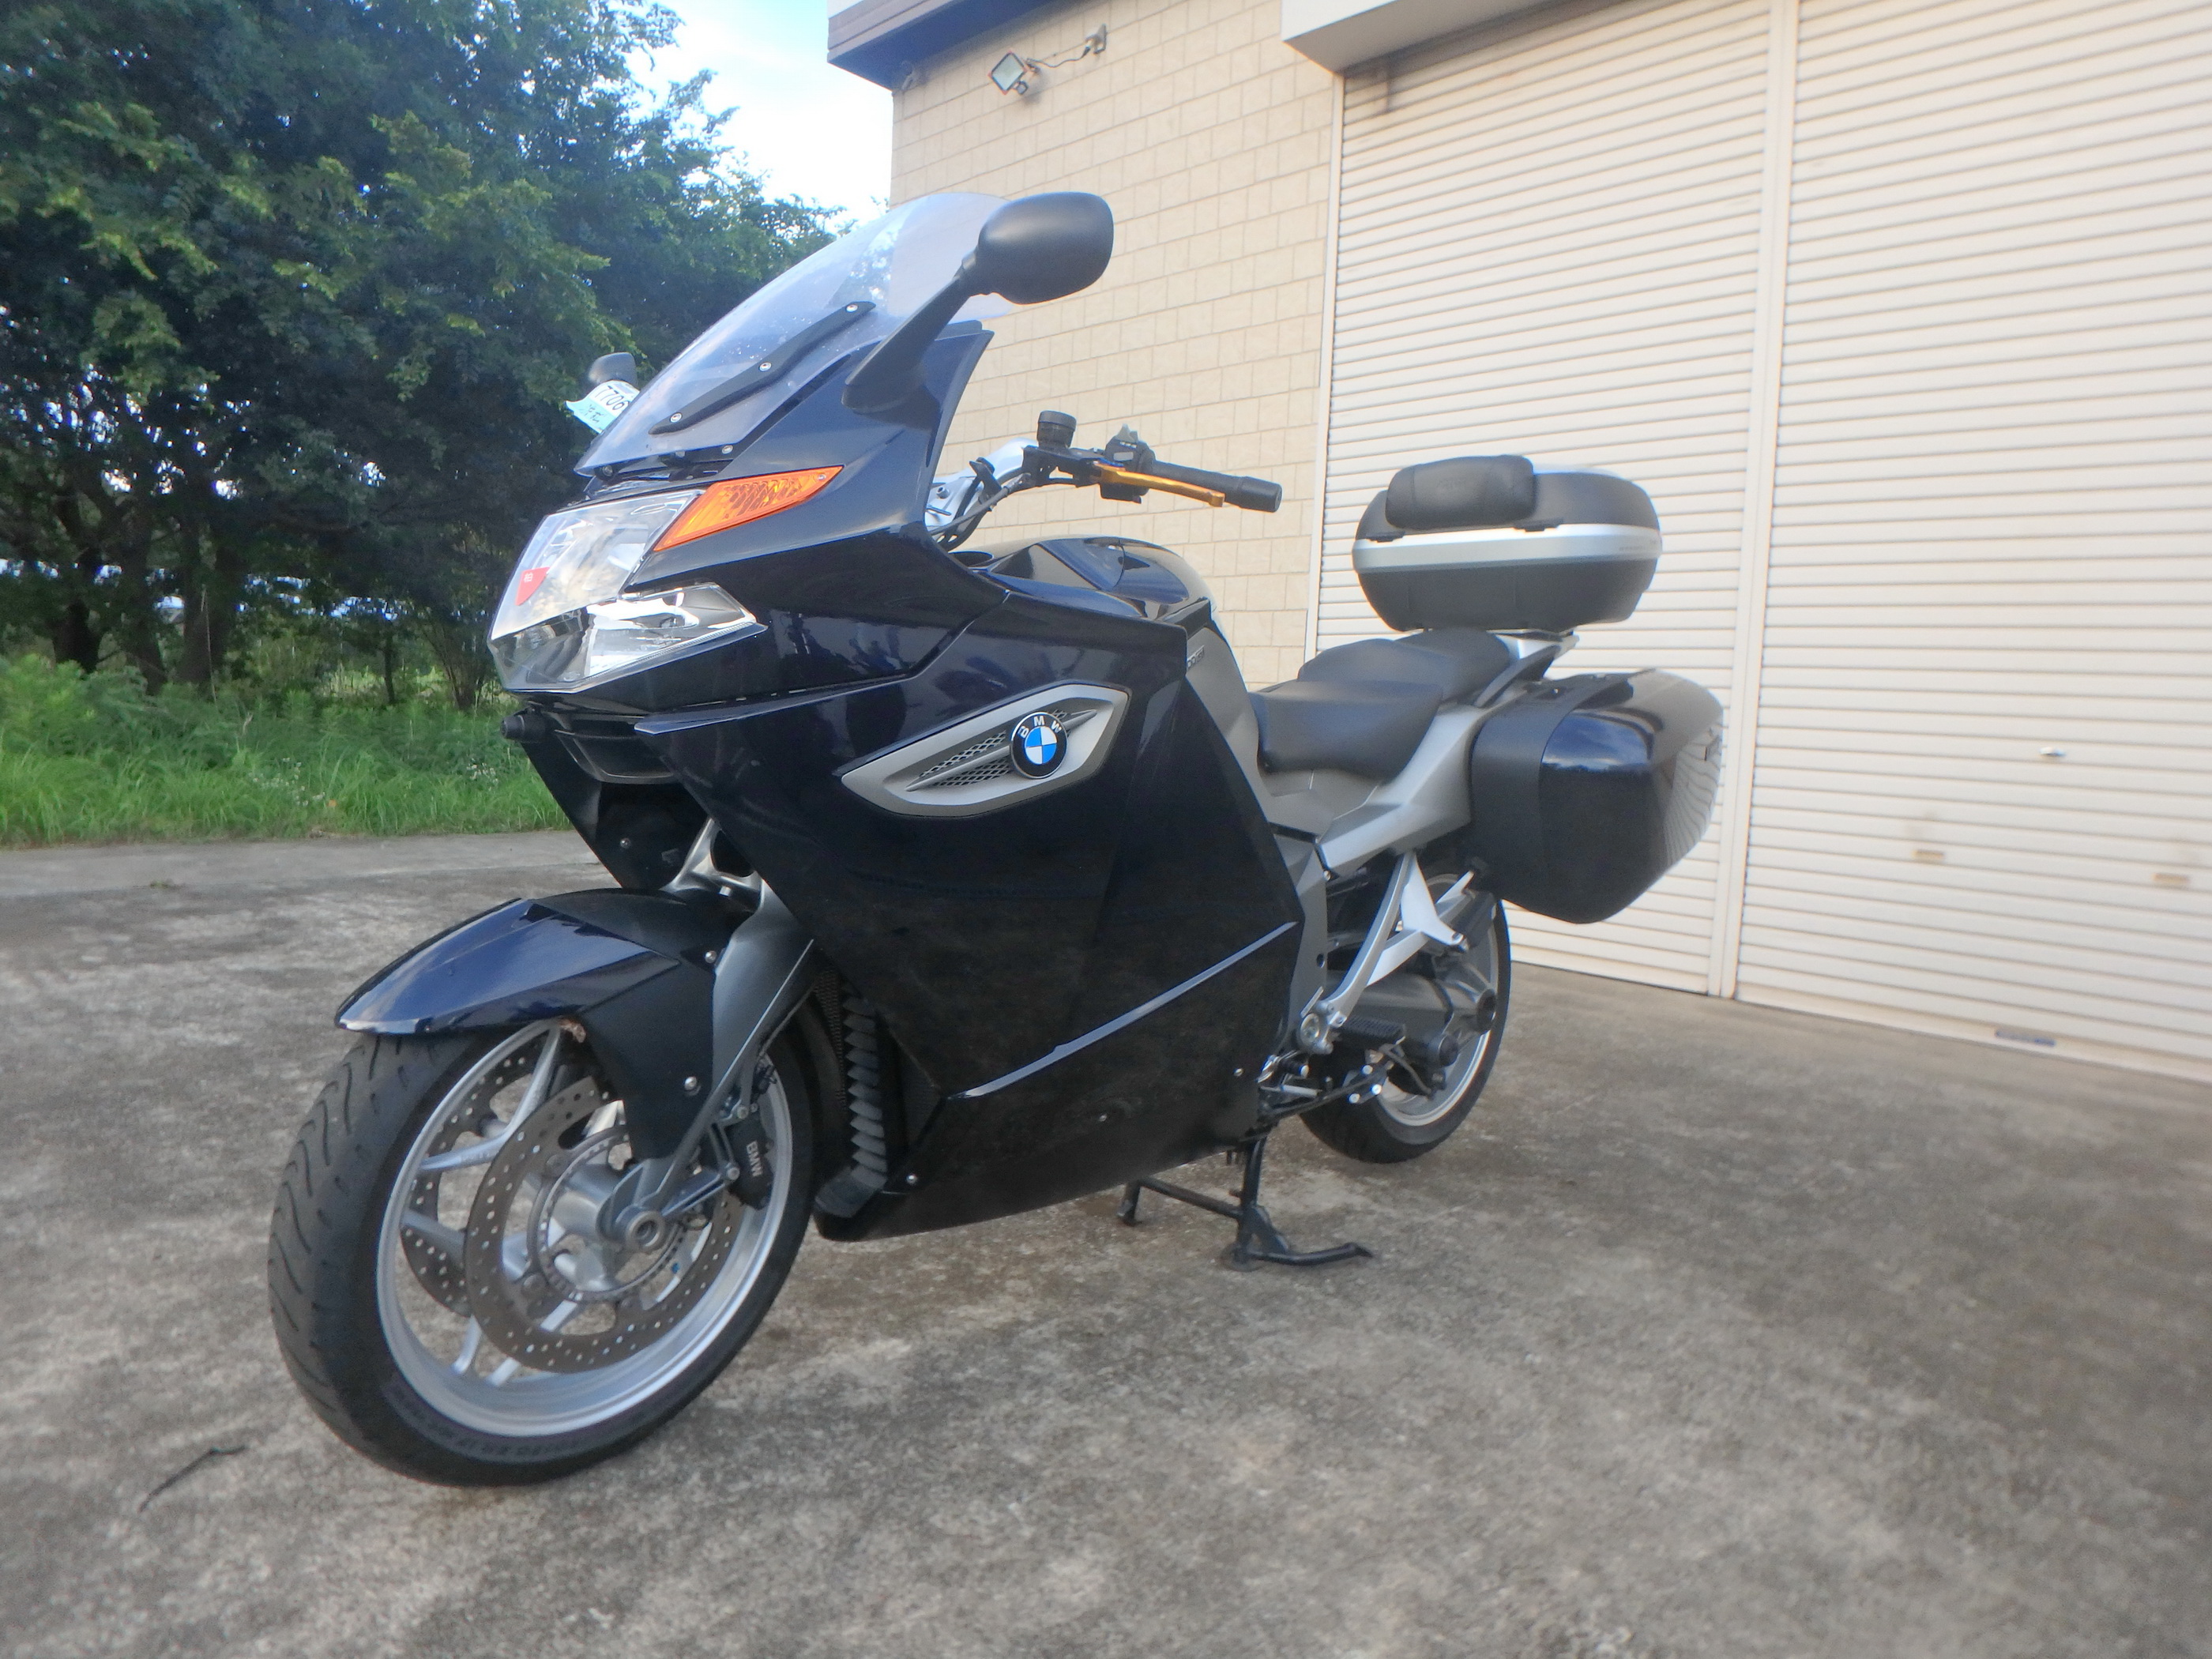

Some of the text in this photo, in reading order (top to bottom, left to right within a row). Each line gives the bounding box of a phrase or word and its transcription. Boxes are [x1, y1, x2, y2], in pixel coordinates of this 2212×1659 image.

[595, 385, 630, 410] 7706
[1019, 715, 1063, 739] BMW
[747, 1140, 763, 1177] BMW
